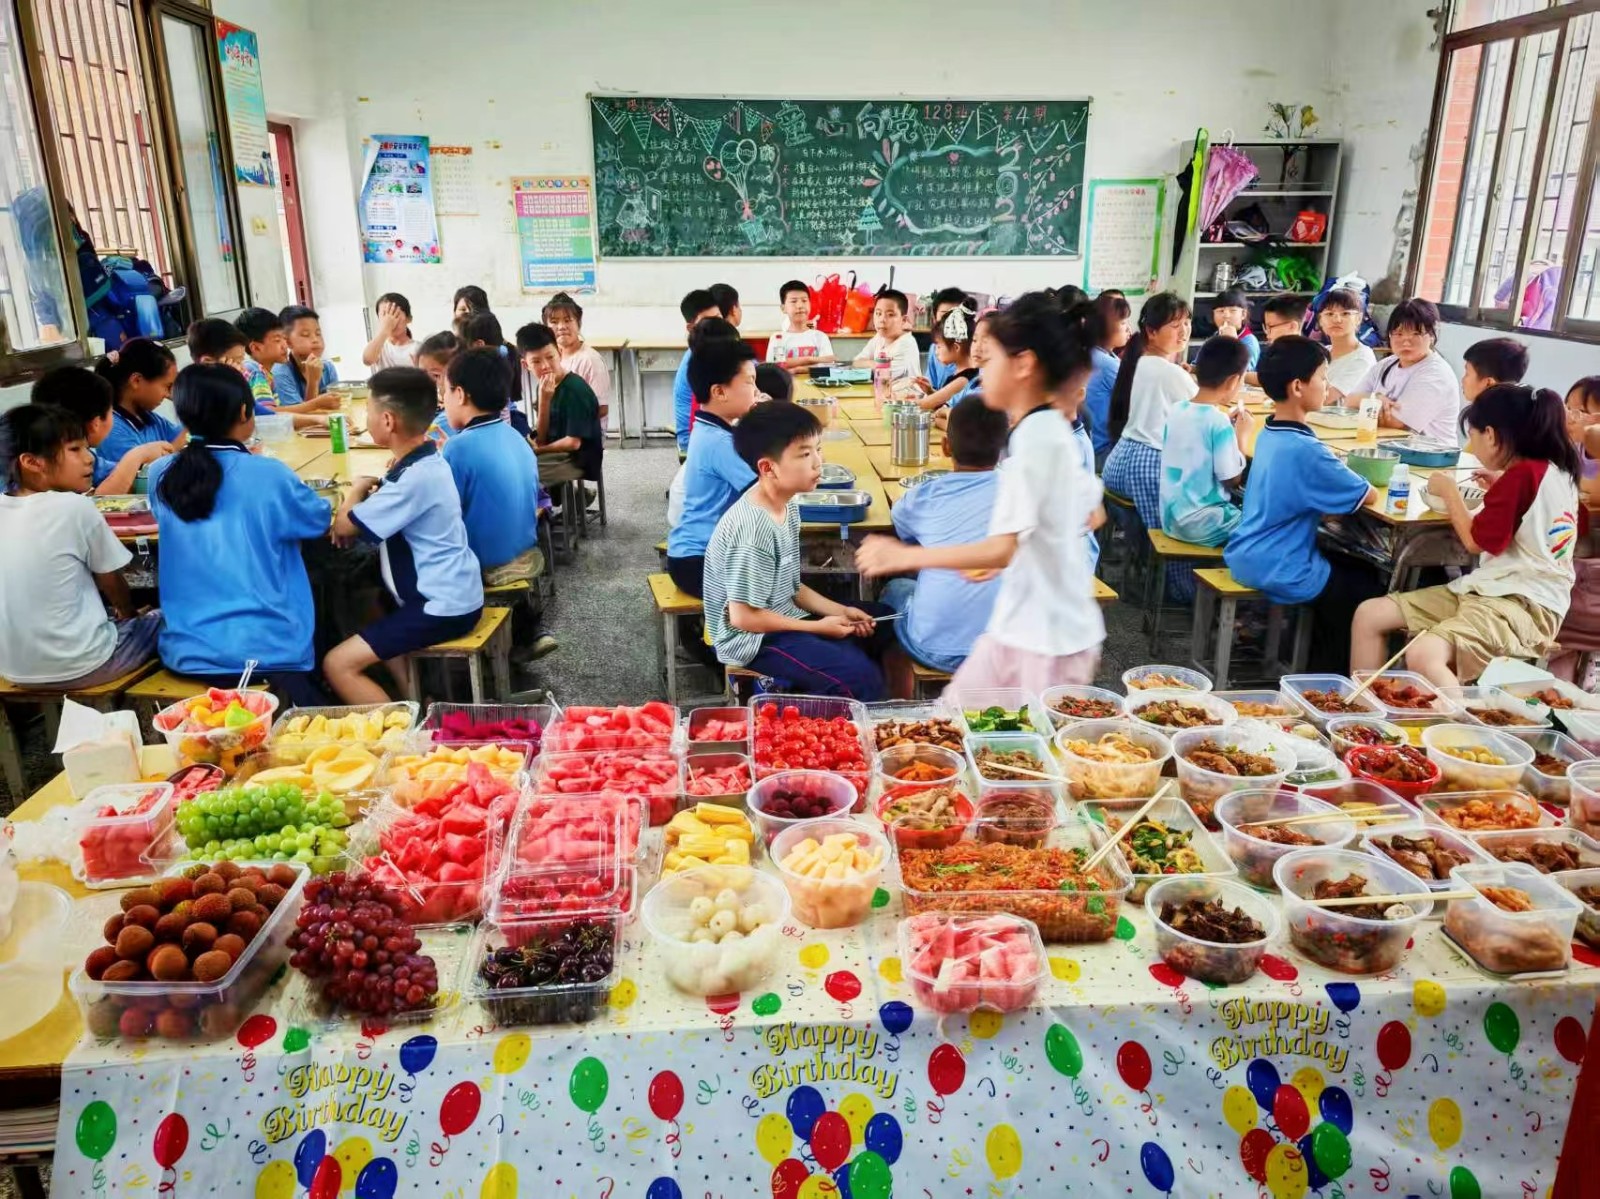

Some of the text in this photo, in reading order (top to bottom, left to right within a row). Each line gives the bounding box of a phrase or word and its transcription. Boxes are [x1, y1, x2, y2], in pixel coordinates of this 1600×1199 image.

[775, 101, 919, 147] 童心向党
[1218, 995, 1331, 1035] Happy
[764, 1021, 879, 1059] Happy
[1209, 1026, 1349, 1073] Birthday
[285, 1061, 396, 1100] Happy
[749, 1051, 899, 1099] Birthday
[258, 1091, 409, 1143] Birthday
